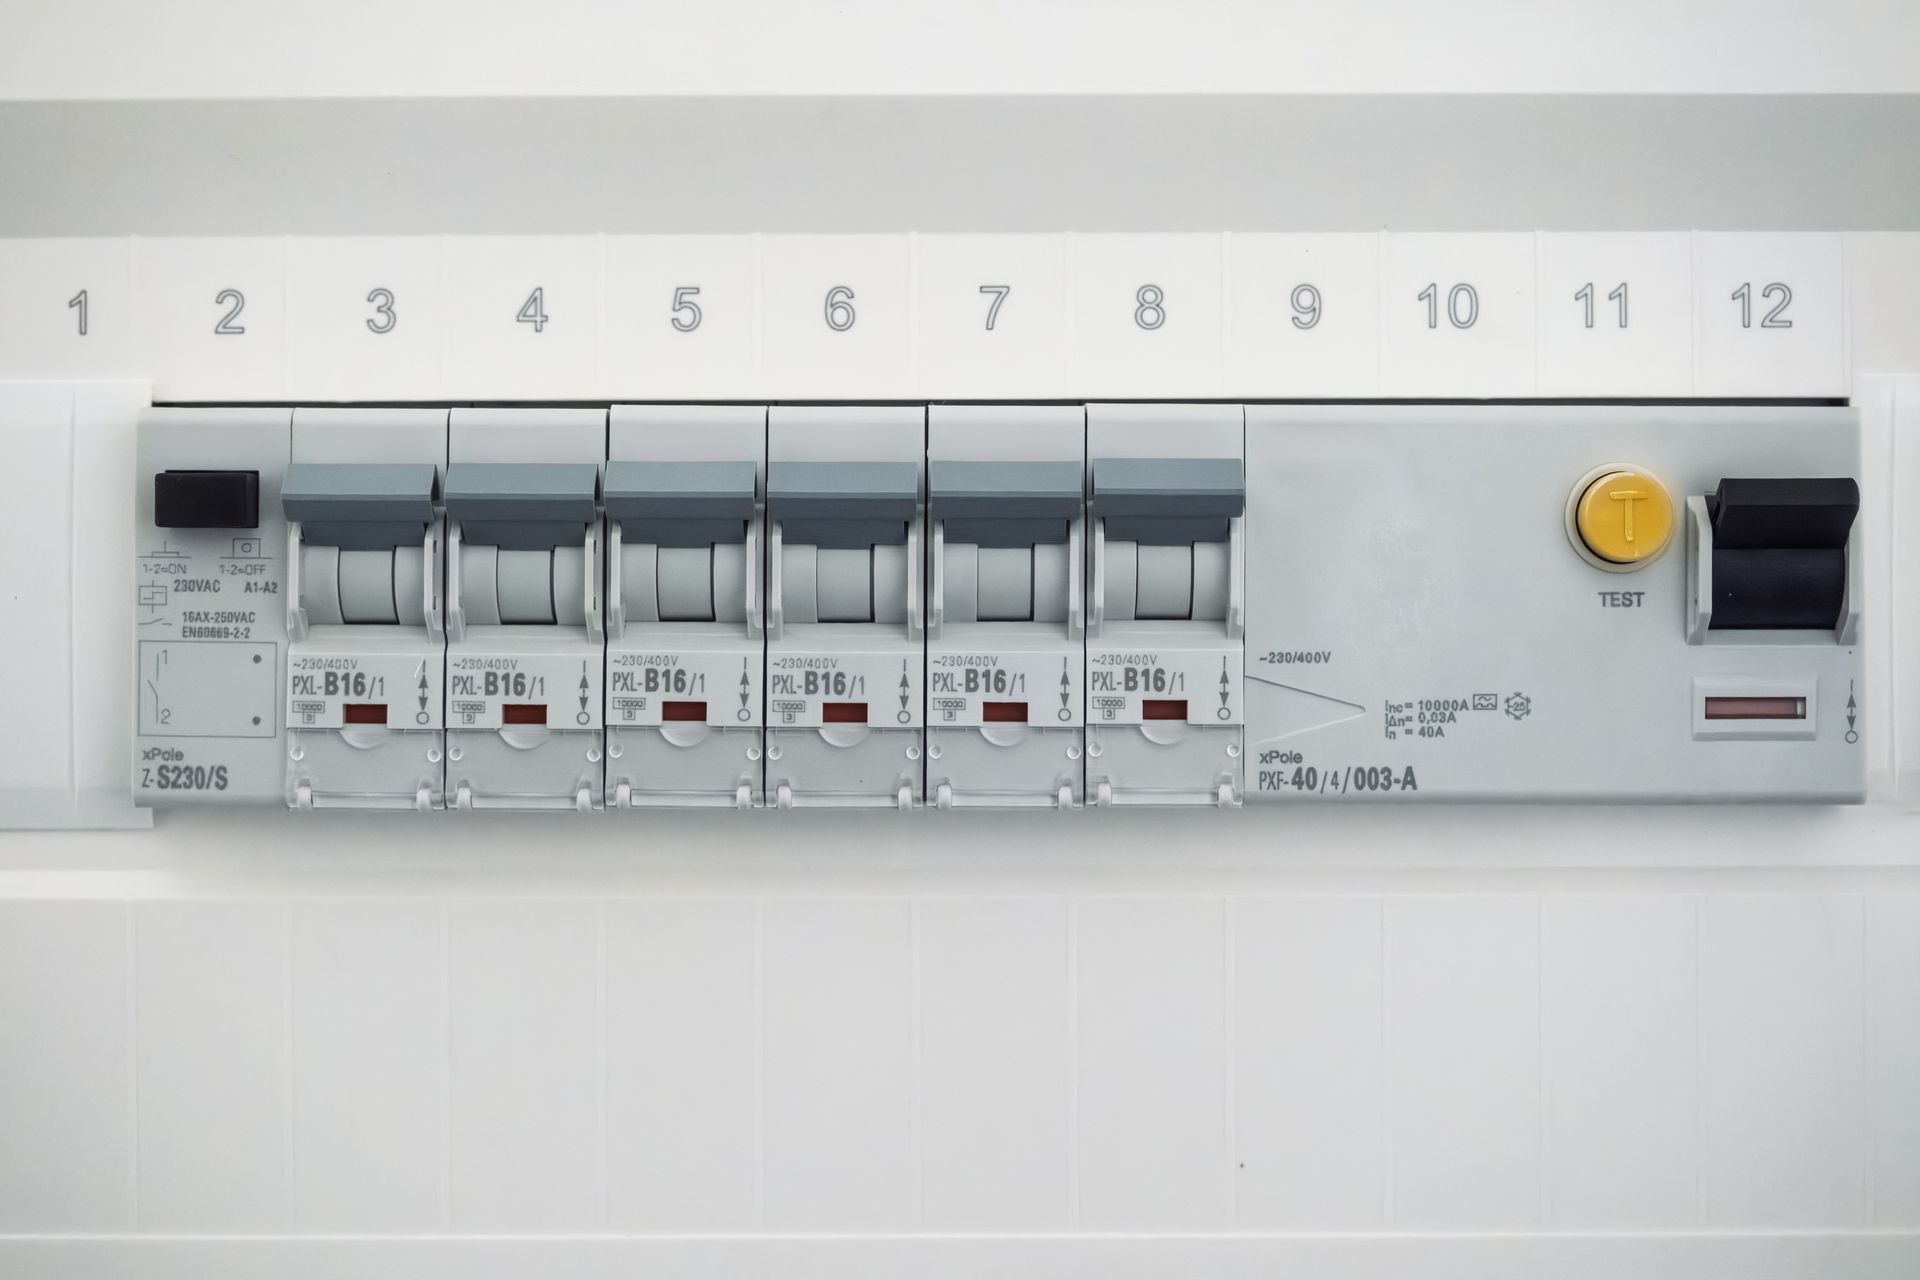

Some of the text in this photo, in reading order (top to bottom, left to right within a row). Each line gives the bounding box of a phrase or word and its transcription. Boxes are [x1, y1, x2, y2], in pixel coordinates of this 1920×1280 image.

[67, 288, 89, 337] 1
[213, 288, 246, 336] 2
[365, 287, 398, 335] 3
[515, 285, 550, 334] 4
[670, 286, 703, 333] 5
[823, 285, 856, 333] 6
[978, 284, 1011, 332] 7
[1133, 283, 1167, 331] 8
[1289, 283, 1323, 331] 9
[1417, 282, 1480, 330] 10
[1573, 281, 1629, 329] 11
[1730, 281, 1793, 329] 12
[1609, 490, 1648, 542] T
[173, 579, 220, 593] 230VAC
[244, 581, 278, 594] A1-A2
[1598, 592, 1645, 607] TEST
[182, 611, 256, 623] 16AX-250VAC
[182, 627, 250, 638] EN60669-2-2
[162, 649, 168, 664] 1
[161, 709, 171, 724] 2
[1418, 700, 1468, 712] 10000A
[1418, 712, 1456, 724] 0,03A
[142, 748, 184, 761] xPole
[1418, 726, 1444, 738] 40A
[1260, 750, 1302, 764] xPole
